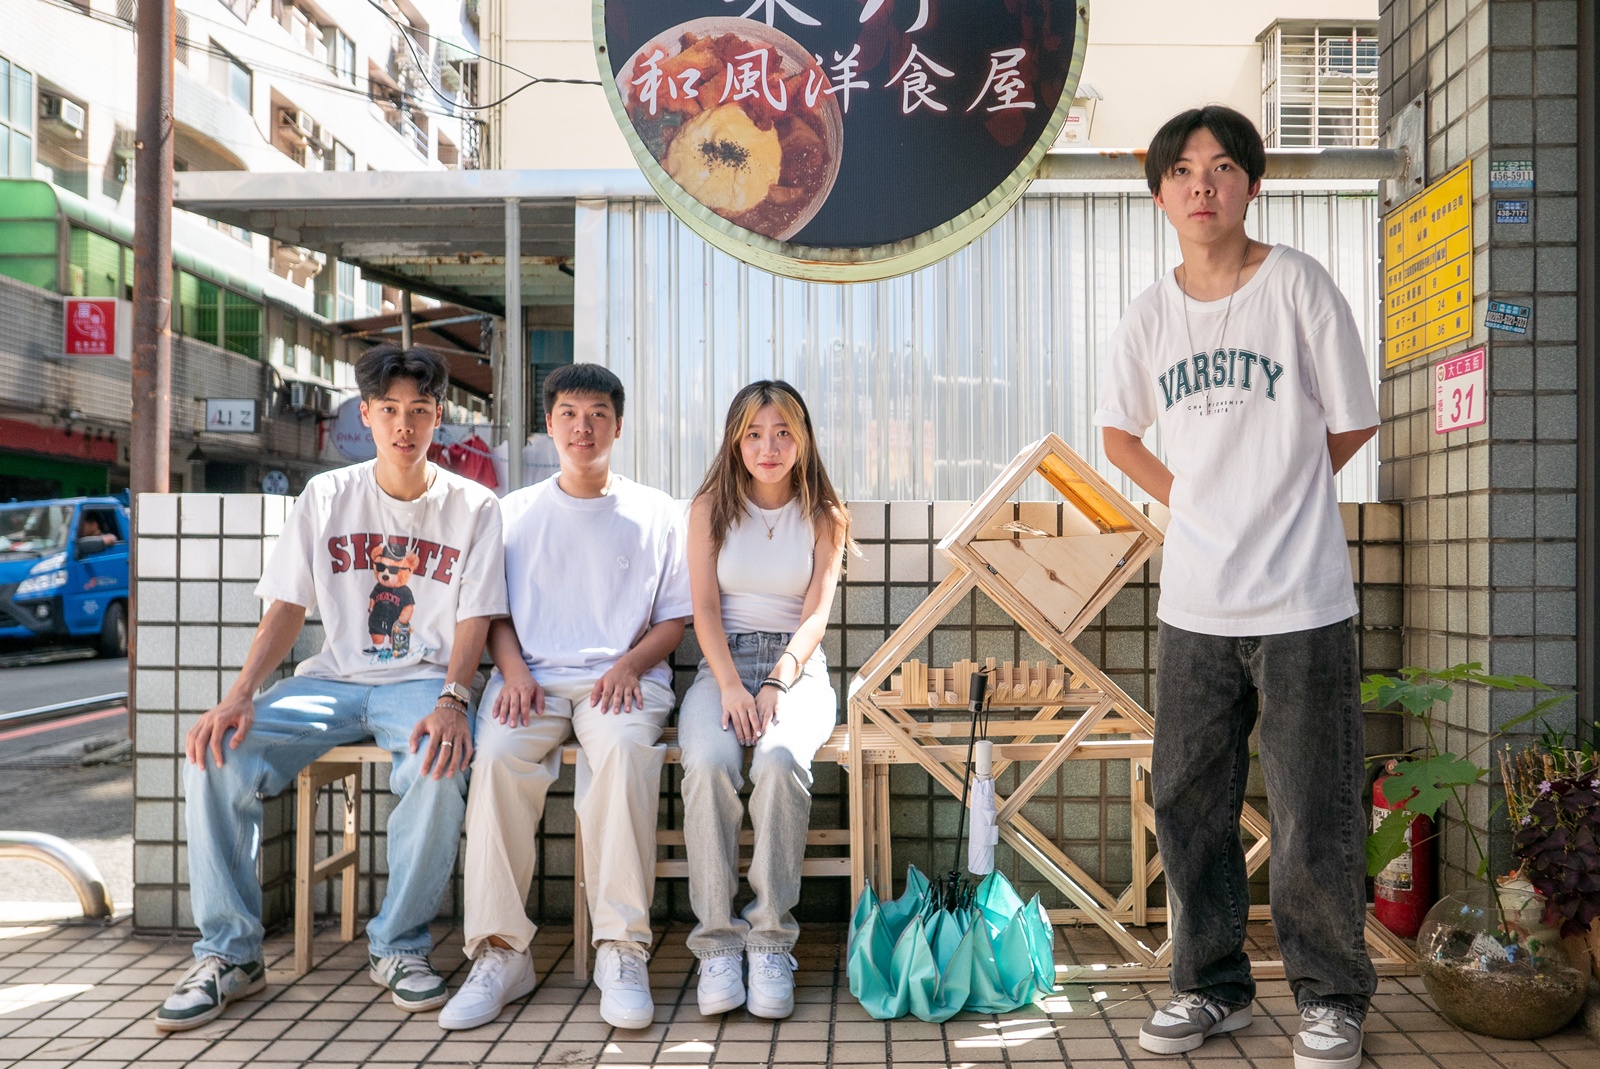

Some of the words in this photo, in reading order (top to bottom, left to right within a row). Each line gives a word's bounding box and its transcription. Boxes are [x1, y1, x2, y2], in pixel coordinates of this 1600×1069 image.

[631, 43, 1036, 115] 和風洋食屋
[1492, 172, 1532, 181] 456-5911
[1396, 310, 1416, 330] 地下一層
[1437, 298, 1445, 311] 24
[1396, 335, 1416, 352] 地下二層
[1437, 324, 1445, 336] 36
[1158, 348, 1284, 412] VARSITY
[1448, 356, 1480, 378] 大仁五街
[1188, 400, 1244, 410] CHAPIONSHIP
[1450, 383, 1474, 423] 31
